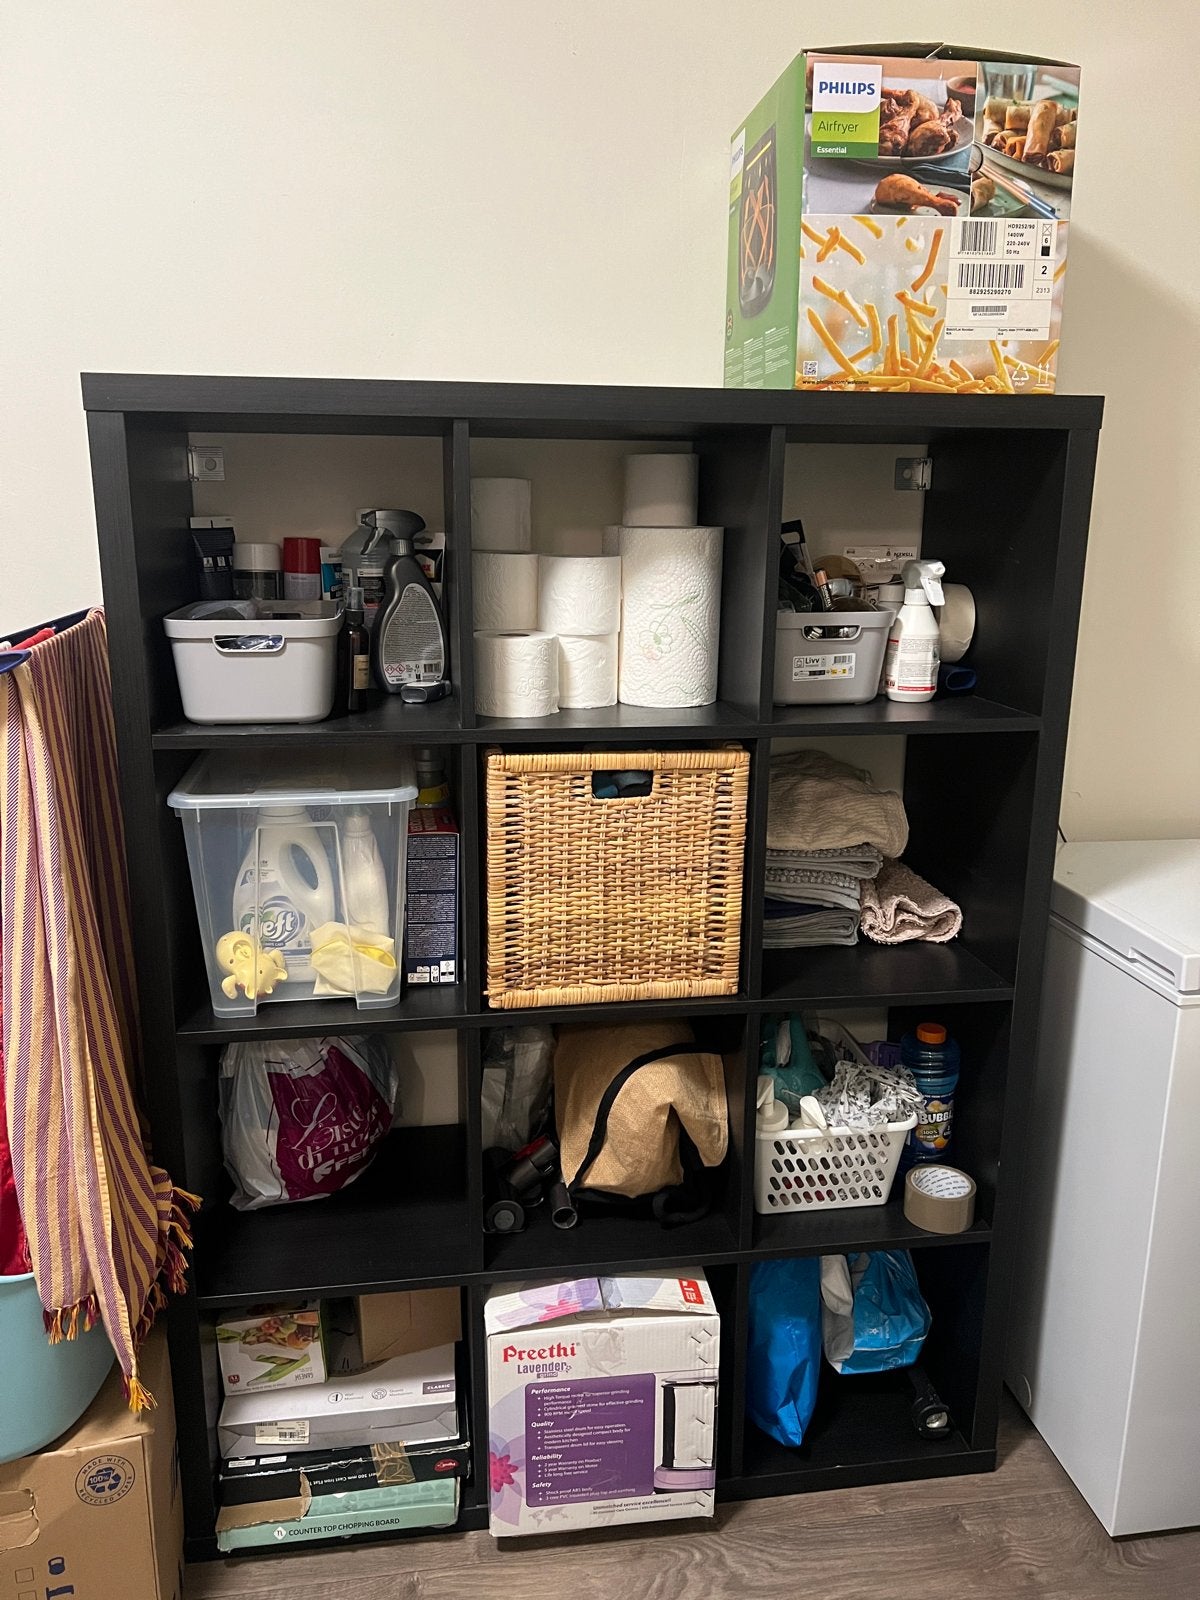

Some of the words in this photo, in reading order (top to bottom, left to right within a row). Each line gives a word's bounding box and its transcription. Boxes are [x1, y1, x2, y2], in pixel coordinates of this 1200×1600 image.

[819, 81, 875, 95] PHILIPS
[818, 121, 859, 134] Airfryer
[817, 146, 847, 154] Essential
[1041, 266, 1048, 275] 2
[503, 1342, 576, 1362] Preethi
[518, 1362, 567, 1374] Lavender
[82, 1459, 102, 1474] MADE
[107, 1457, 126, 1466] WITH
[90, 1475, 110, 1484] 100%
[80, 1489, 114, 1504] RECYCLED
[289, 1527, 322, 1536] COUNTER
[338, 1521, 374, 1530] CHOPPING
[376, 1518, 400, 1526] BOARD
